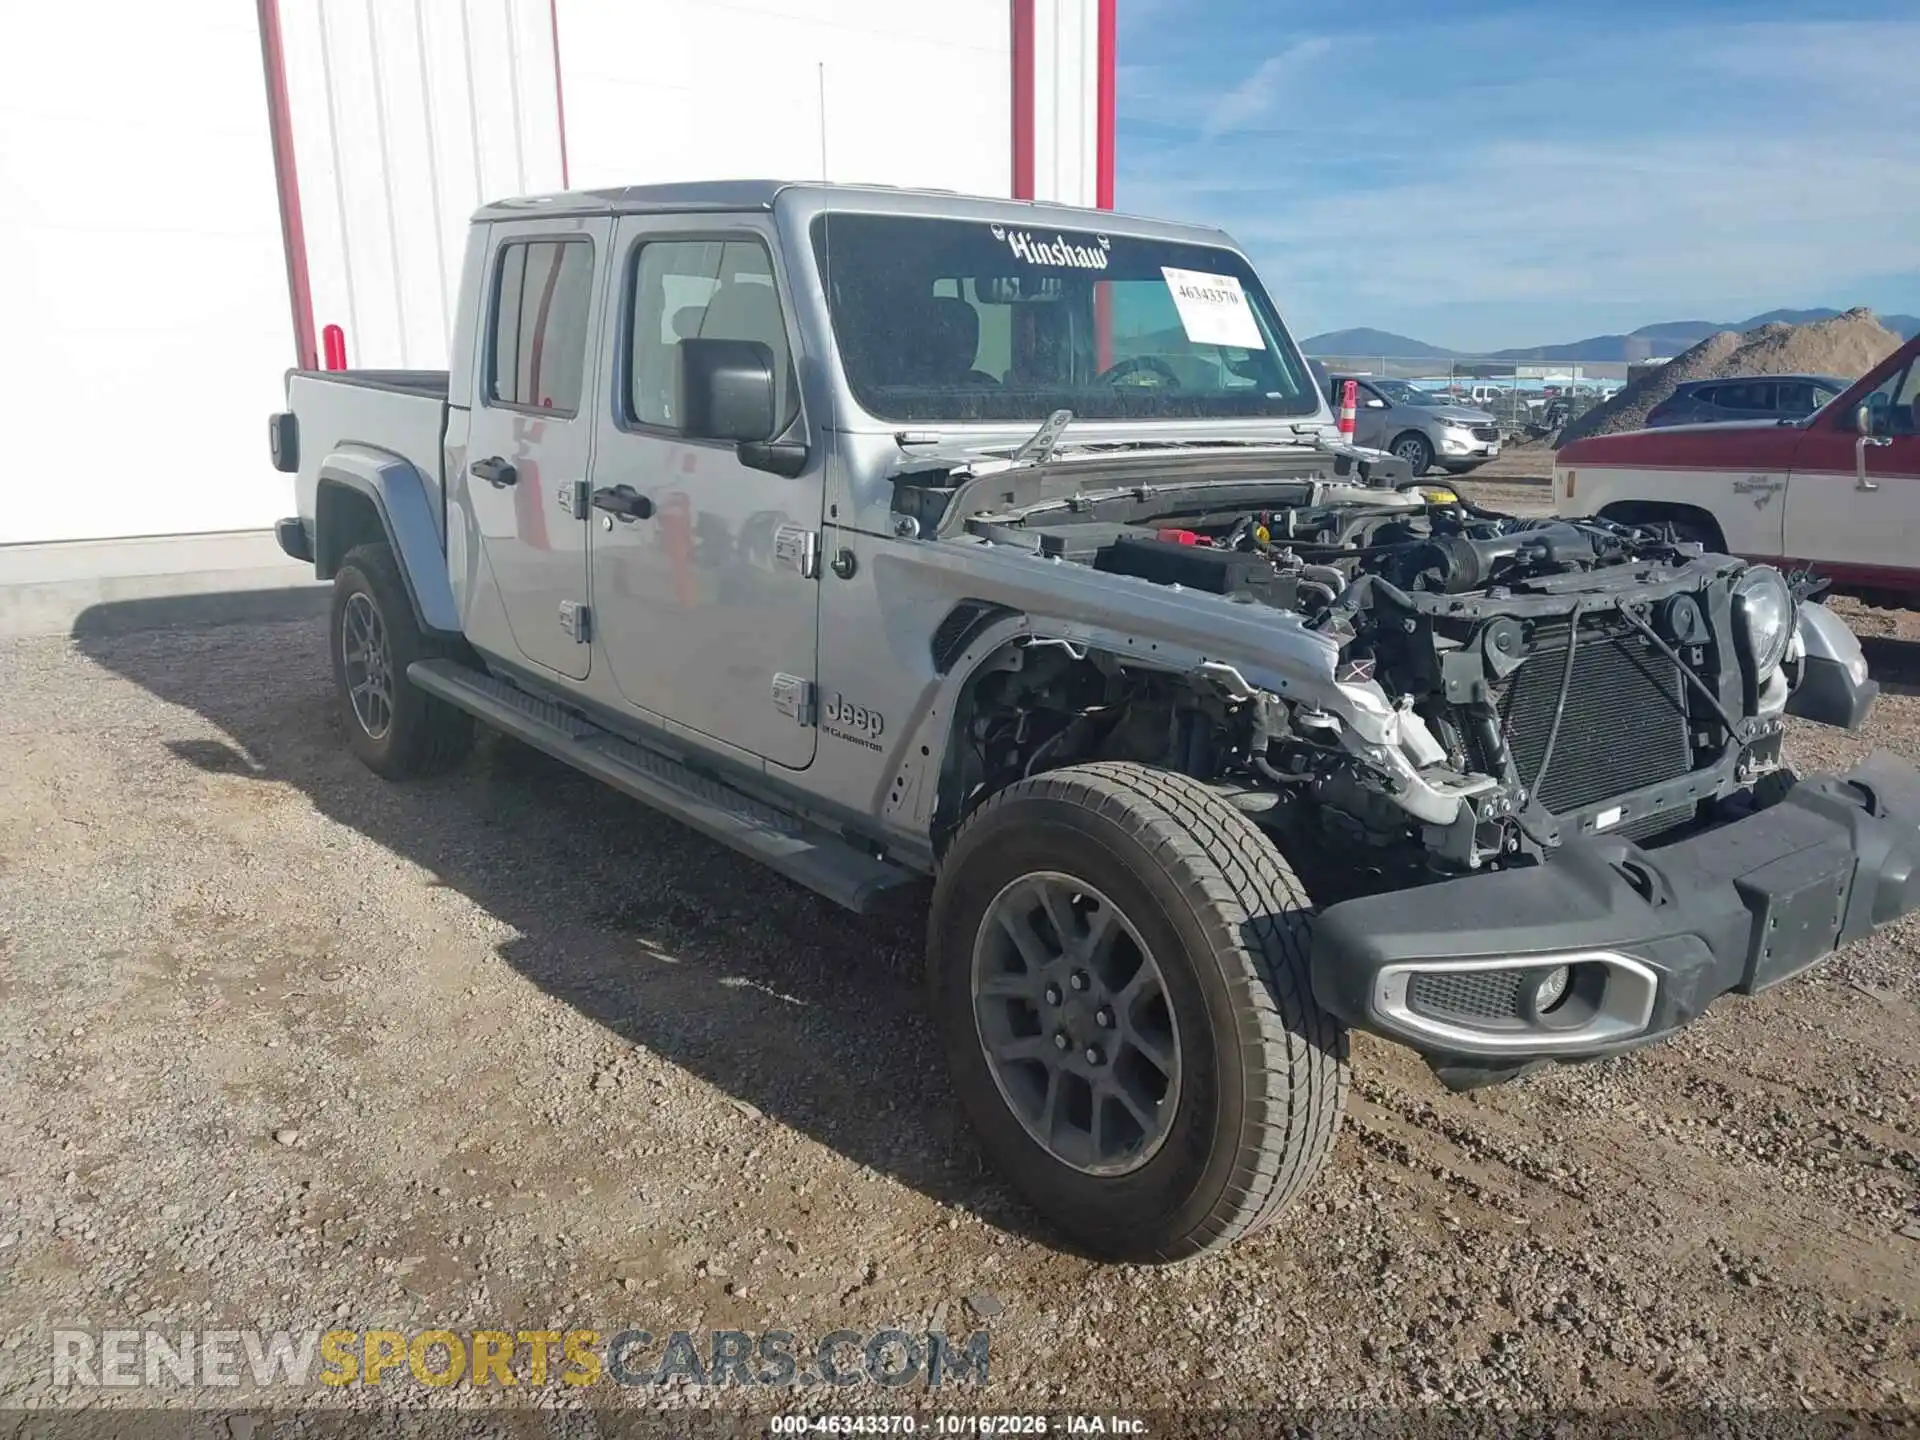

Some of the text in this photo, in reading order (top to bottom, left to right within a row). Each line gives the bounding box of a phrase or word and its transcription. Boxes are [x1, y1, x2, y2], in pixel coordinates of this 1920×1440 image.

[1007, 231, 1108, 269] Hinshaw
[1179, 285, 1239, 305] 46343370
[826, 691, 884, 739] Jeep
[830, 727, 883, 752] GLADIATOR
